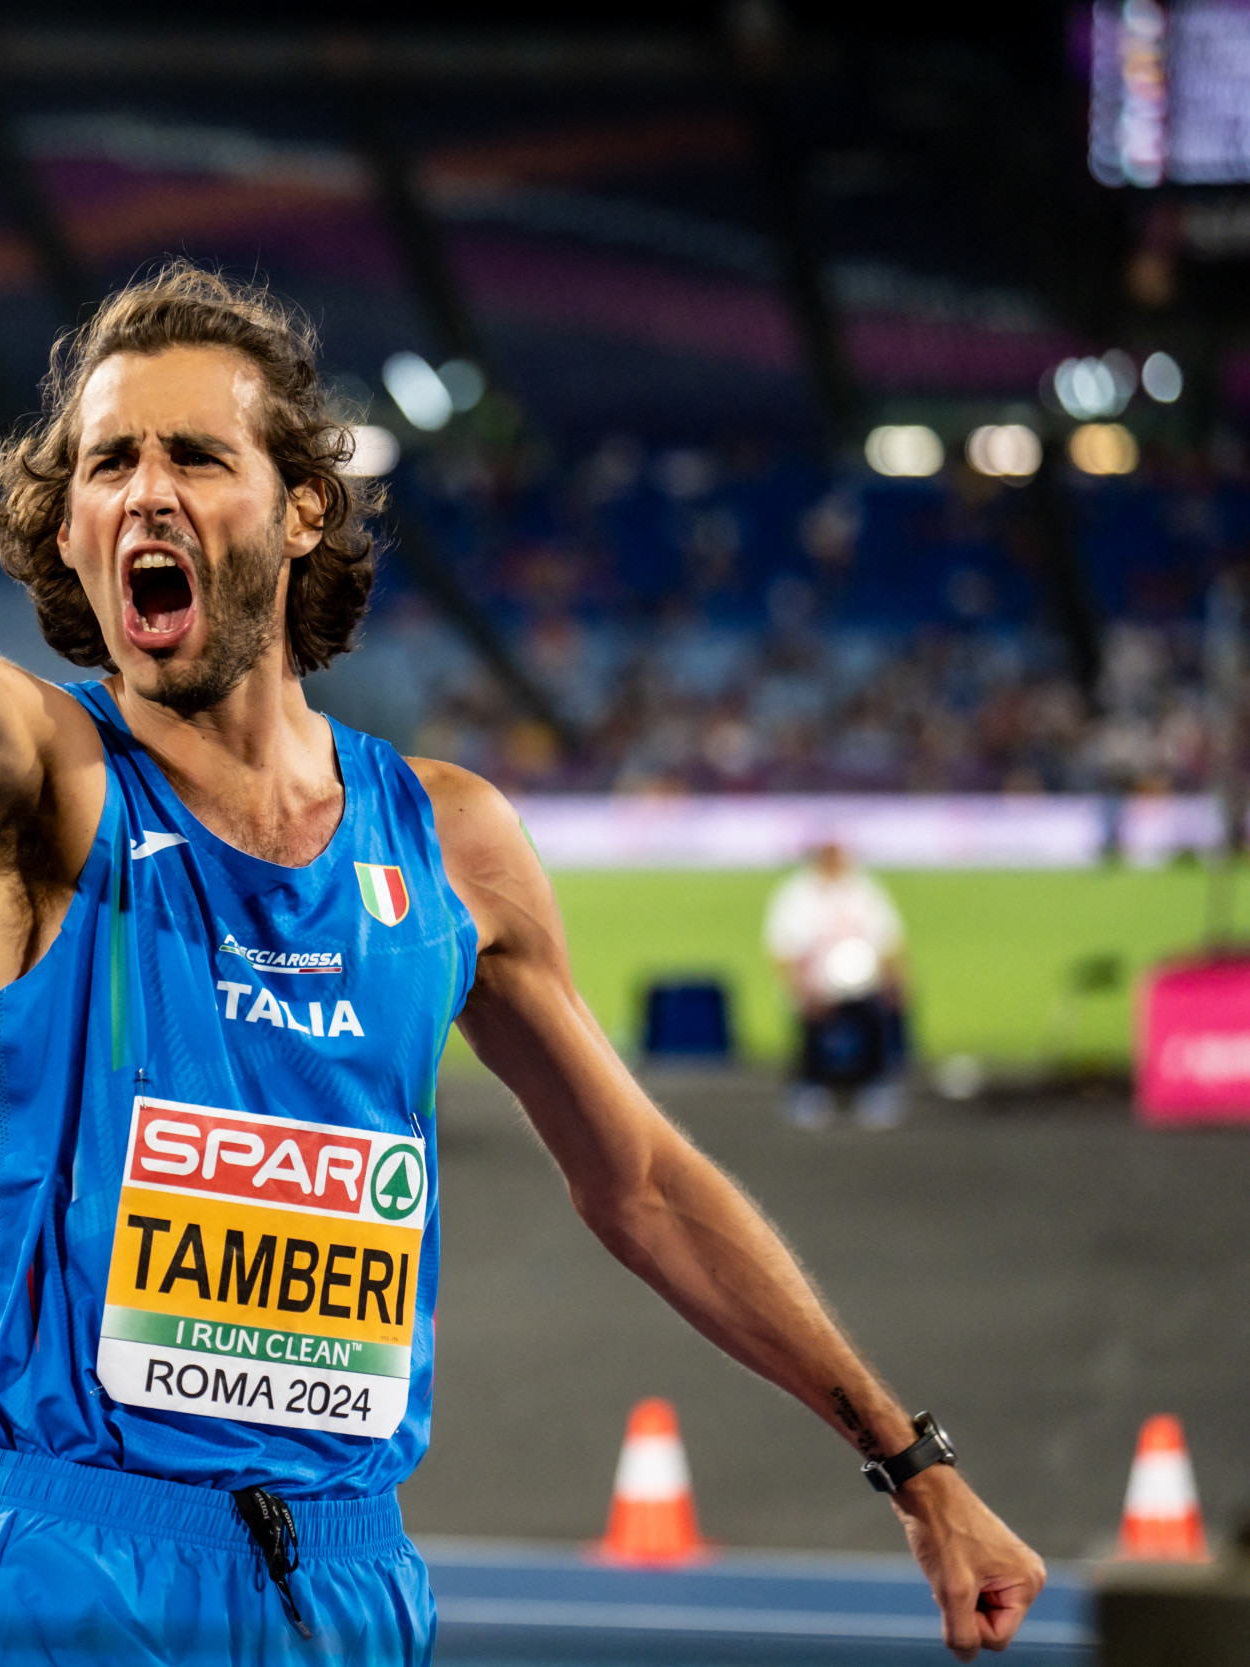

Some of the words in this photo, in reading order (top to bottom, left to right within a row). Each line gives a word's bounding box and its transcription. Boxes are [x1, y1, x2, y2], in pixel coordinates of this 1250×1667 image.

[215, 980, 365, 1037] TALIA
[141, 1119, 363, 1202] SPAR
[127, 1214, 409, 1326] TAMBERI
[176, 1320, 185, 1344] I
[191, 1322, 260, 1355] RUN
[144, 1359, 275, 1410] ROMA
[285, 1379, 372, 1422] 2024
